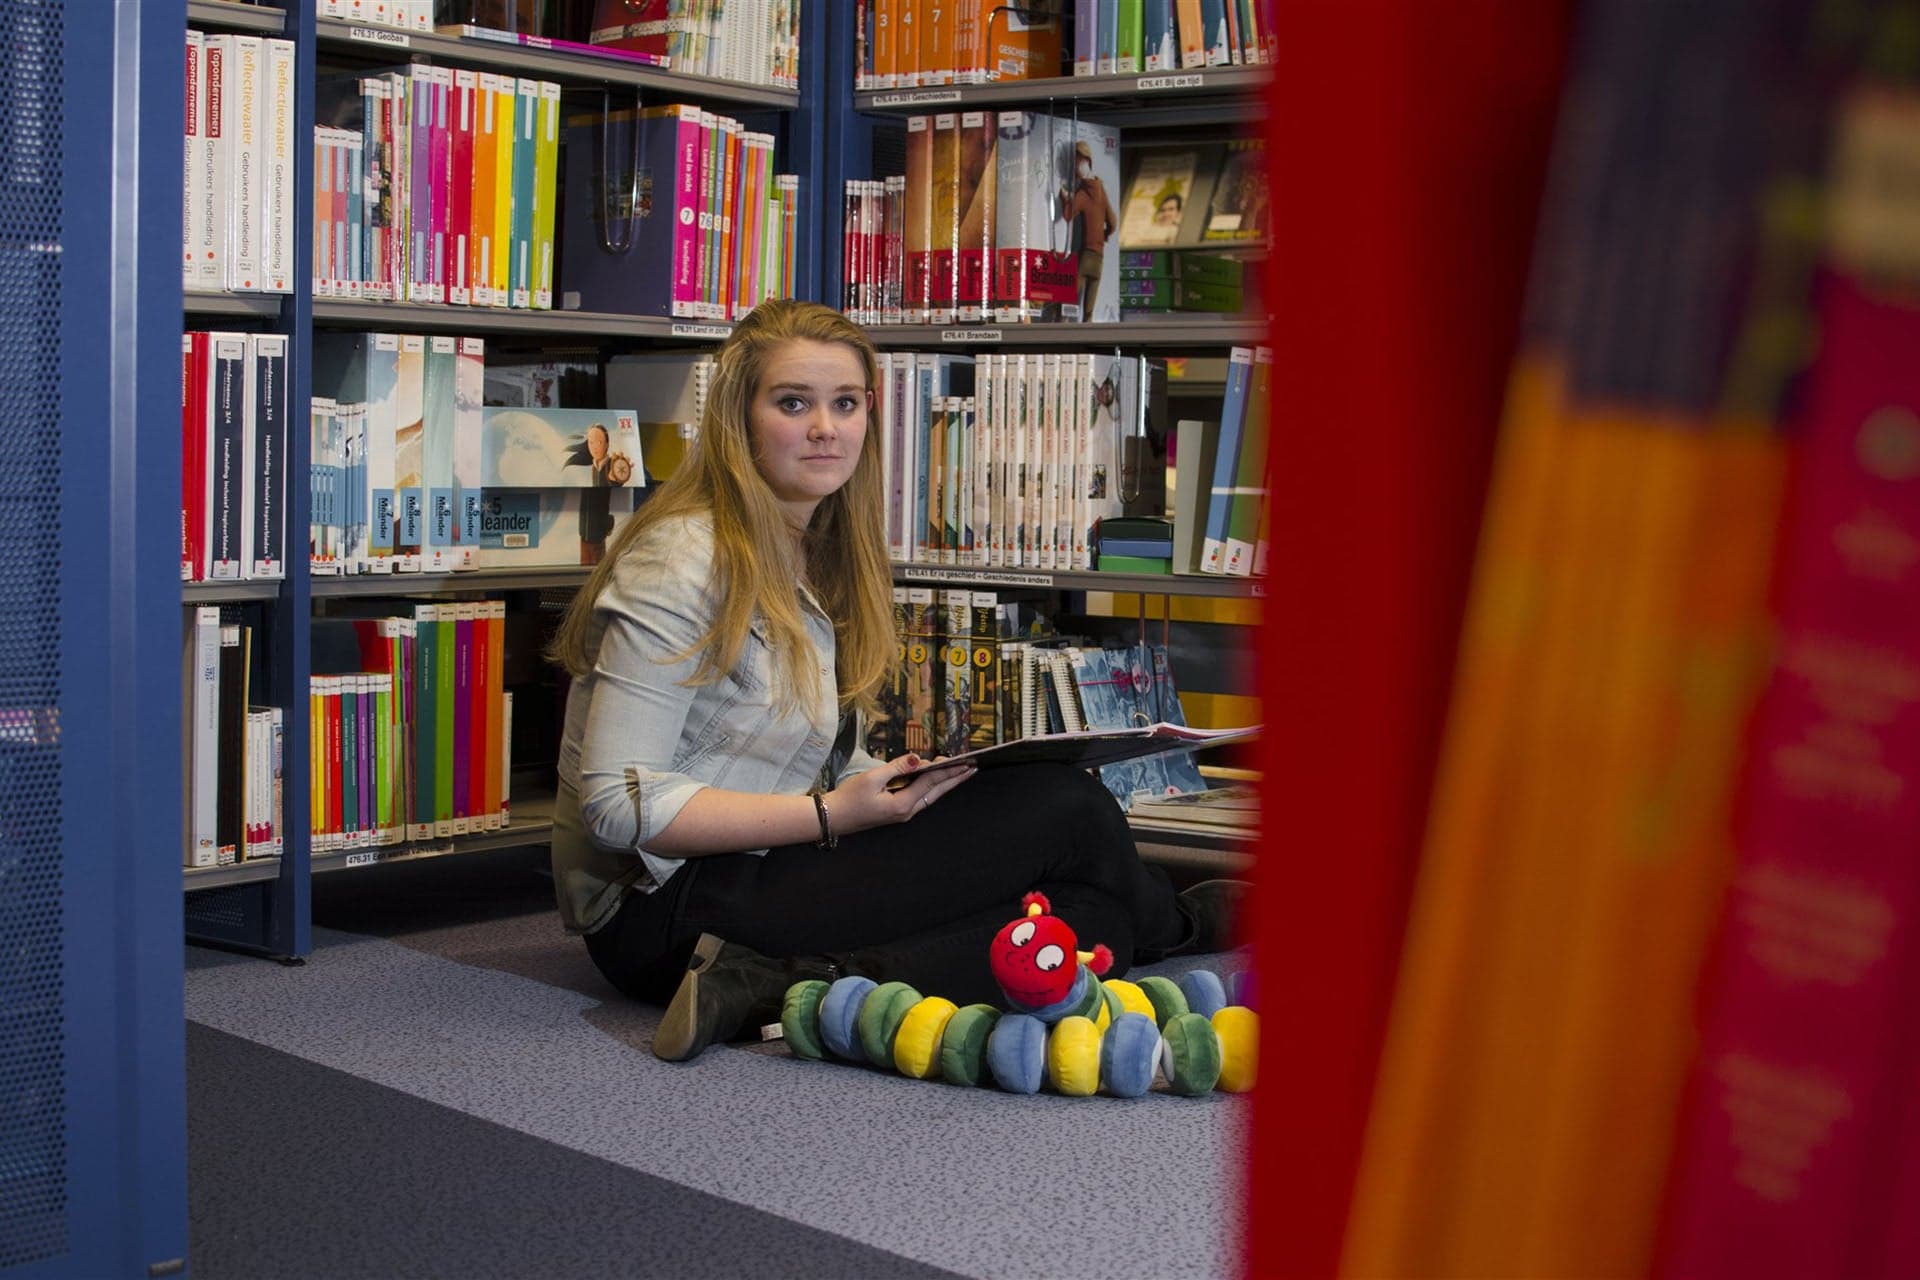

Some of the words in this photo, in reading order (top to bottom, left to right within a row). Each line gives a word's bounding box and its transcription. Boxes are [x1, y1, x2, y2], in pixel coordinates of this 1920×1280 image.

[880, 14, 888, 28] 3
[904, 12, 912, 24] 4
[932, 10, 941, 23] 7
[211, 48, 222, 136] Topondernemers
[275, 60, 288, 158] Reflectiewaaier
[206, 141, 214, 190] Gebruikers
[242, 152, 250, 202] Gebruikers
[274, 164, 284, 215] Gebruikers
[204, 193, 214, 246] handleiding
[241, 202, 250, 258] handleiding
[684, 210, 690, 222] 7
[273, 216, 283, 270] handleiding
[1031, 268, 1075, 286] Brandaan
[380, 497, 388, 540] Meander
[408, 496, 416, 538] Meander
[438, 496, 446, 538] Meander
[467, 496, 475, 538] Meander
[480, 512, 532, 530] eander
[493, 497, 502, 516] 5
[914, 648, 922, 660] 5
[955, 650, 962, 662] 7
[980, 652, 986, 664] 8
[348, 854, 370, 864] 476.31
